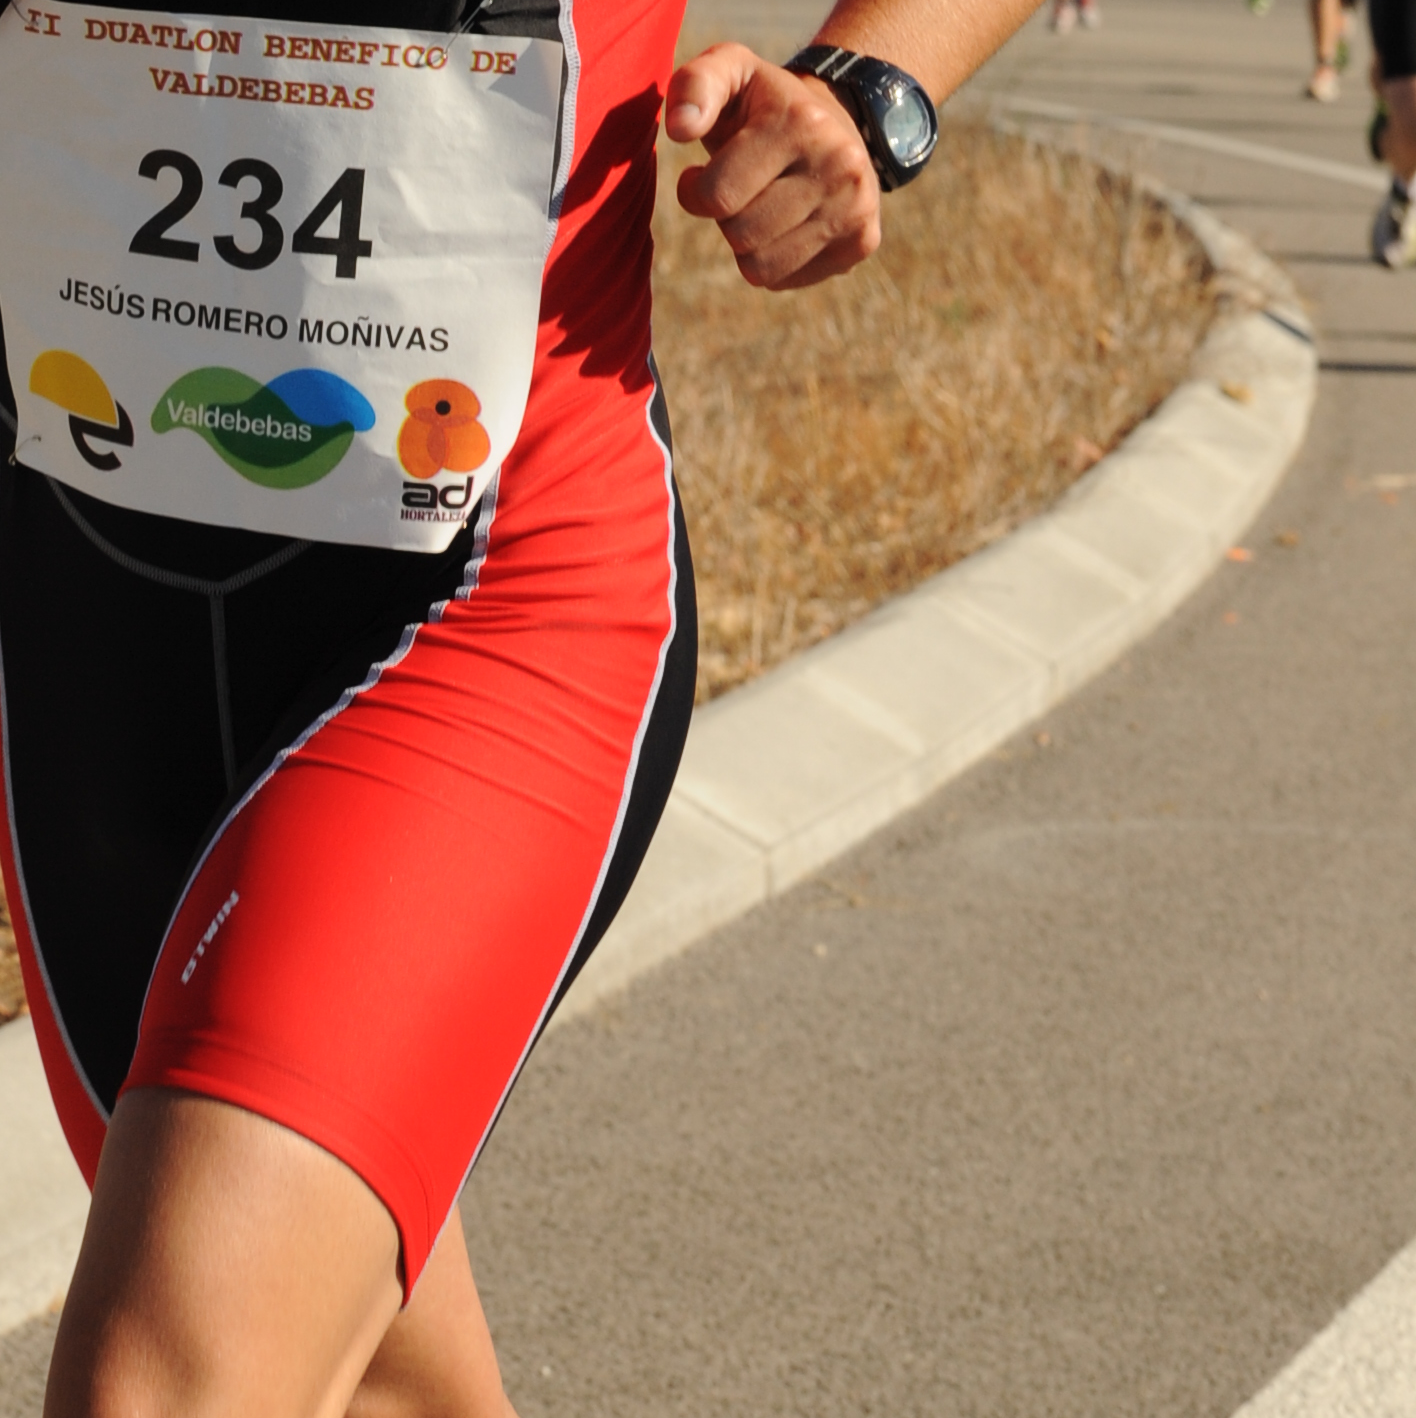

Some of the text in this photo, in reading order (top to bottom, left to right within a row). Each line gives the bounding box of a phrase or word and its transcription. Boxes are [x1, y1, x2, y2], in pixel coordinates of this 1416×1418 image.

[25, 9, 61, 37] II
[85, 19, 242, 55] DUATLON
[470, 50, 517, 74] DE
[149, 67, 375, 110] VALDEBEBAS
[128, 149, 373, 279] 234
[59, 278, 449, 352] JESÚS ROMERO MOÑIVAS
[166, 397, 313, 443] Valdebebas
[401, 475, 474, 509] ad
